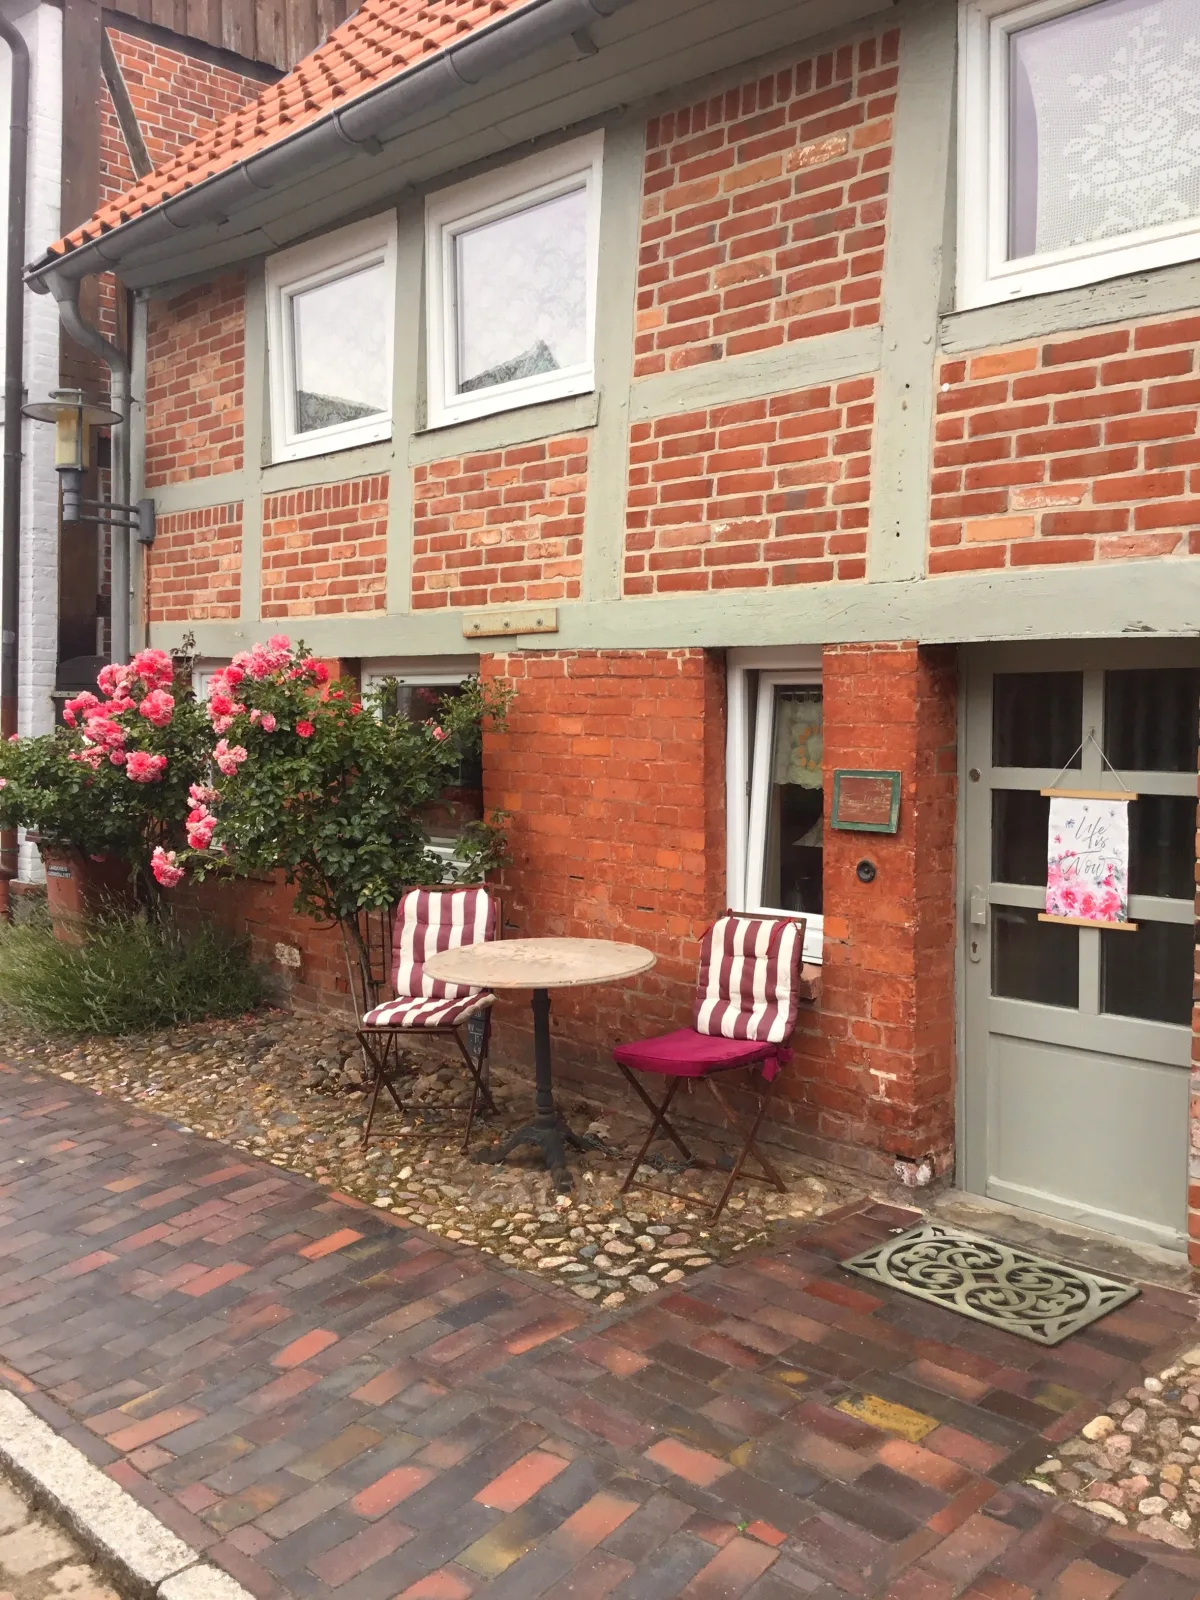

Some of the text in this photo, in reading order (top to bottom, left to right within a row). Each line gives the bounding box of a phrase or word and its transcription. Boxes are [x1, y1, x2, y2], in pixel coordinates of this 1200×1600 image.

[1075, 816, 1109, 849] Life
[1094, 835, 1110, 848] is
[1059, 850, 1123, 877] Now
